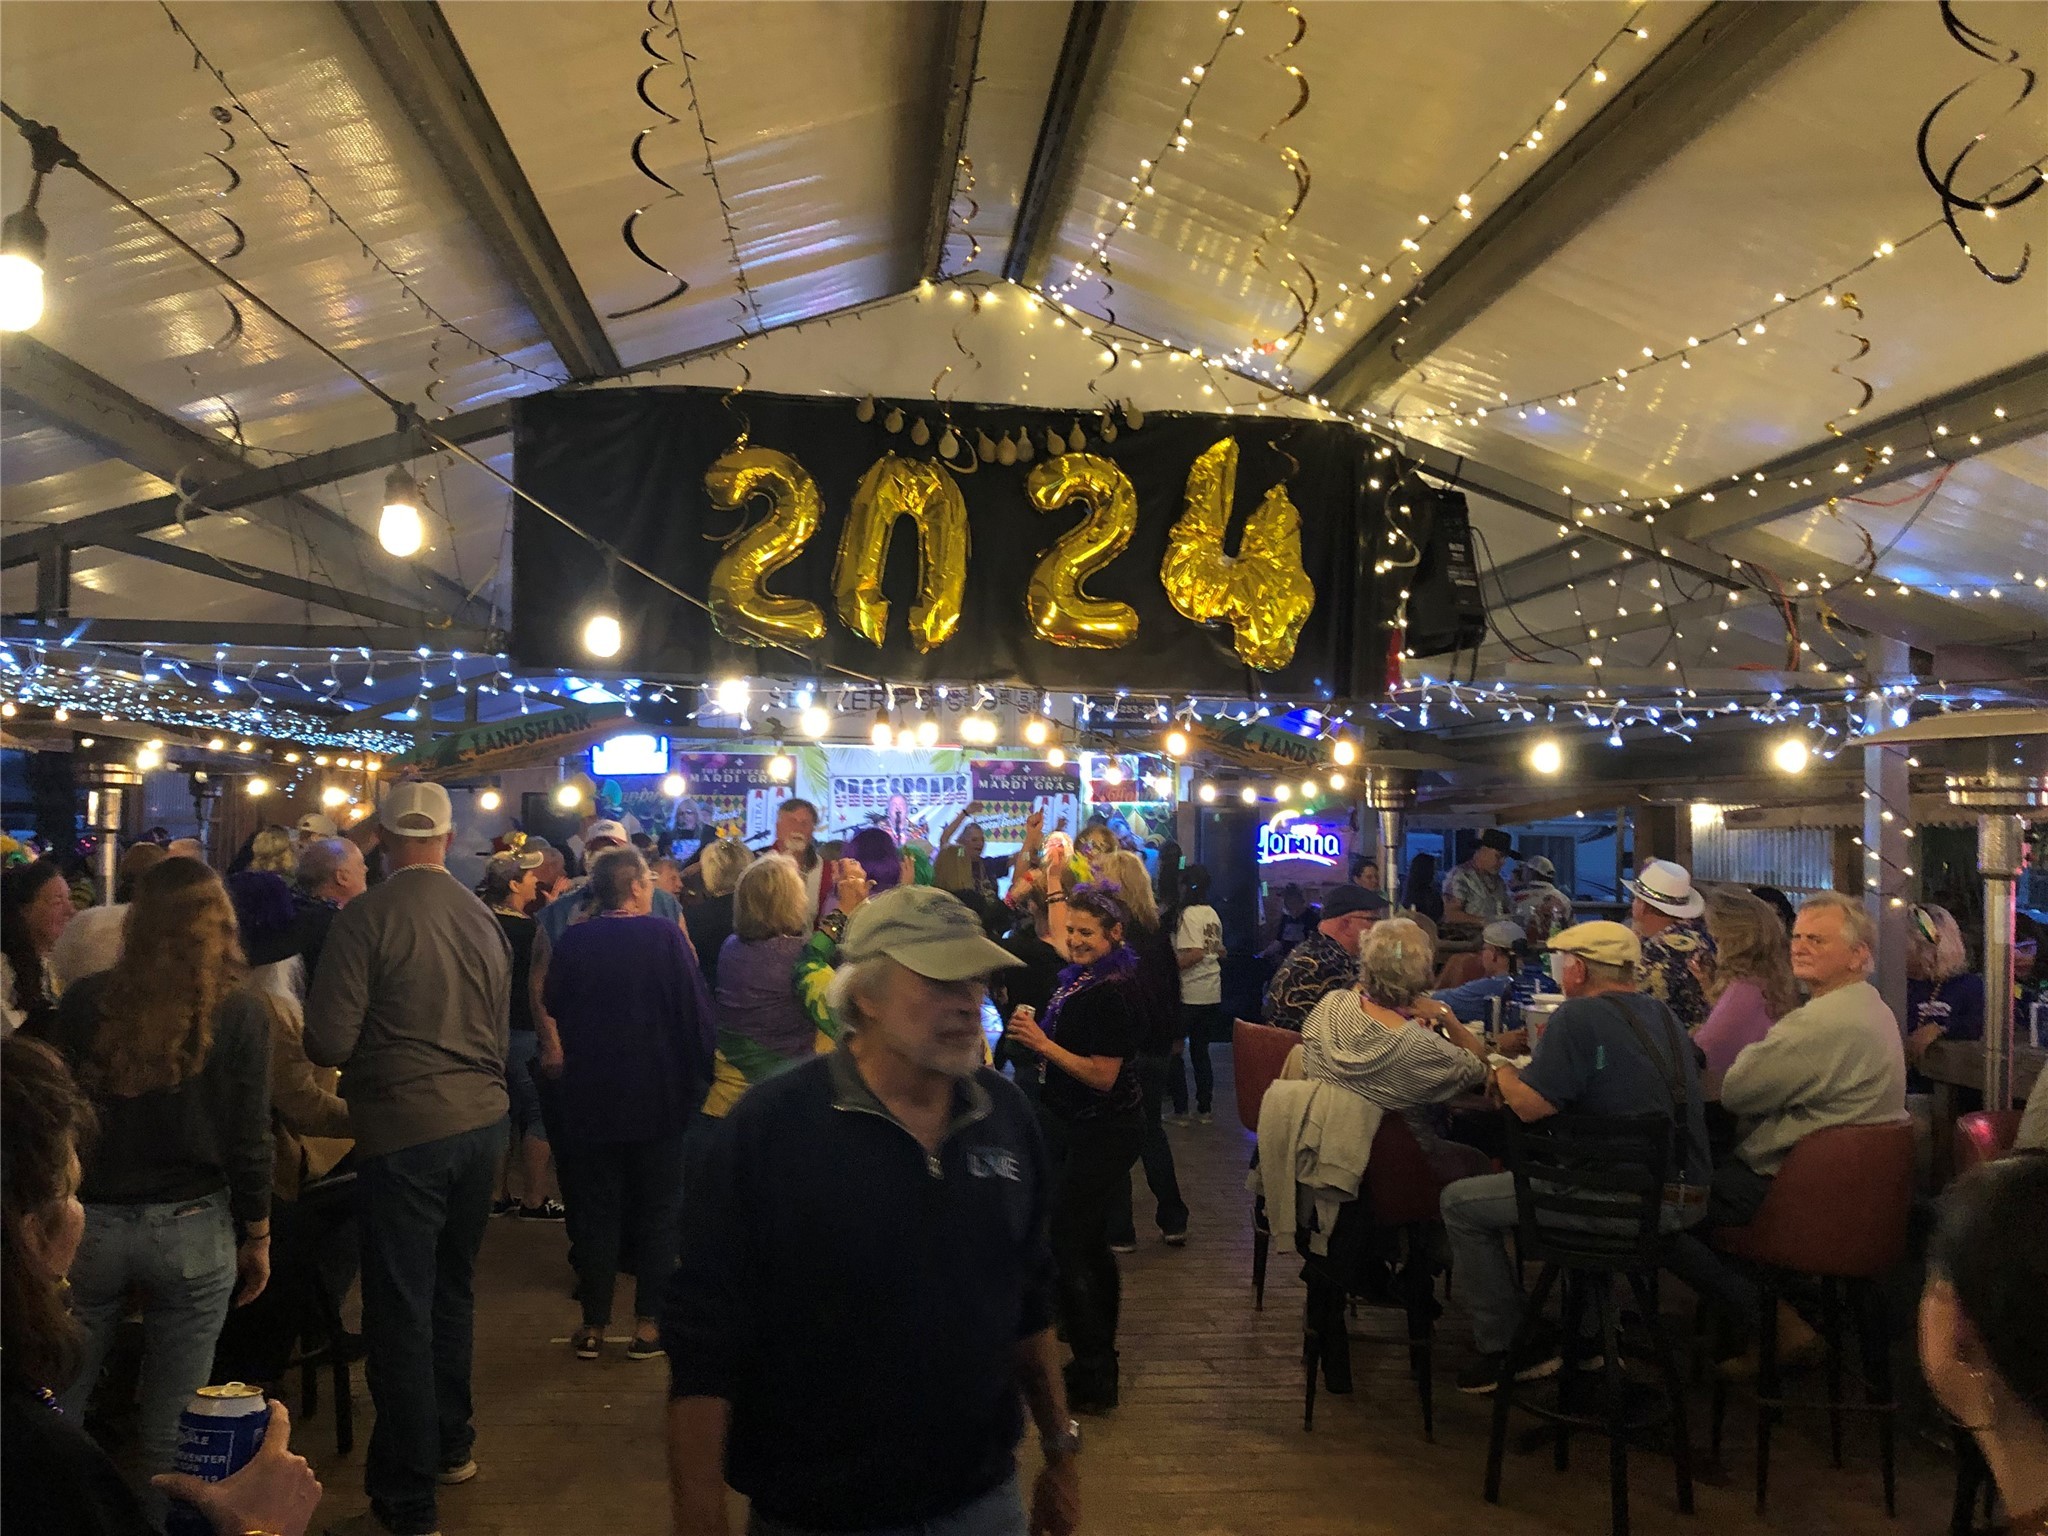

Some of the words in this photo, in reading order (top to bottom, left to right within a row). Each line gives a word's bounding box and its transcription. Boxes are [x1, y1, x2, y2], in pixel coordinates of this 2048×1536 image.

[703, 436, 1315, 671] 2024
[471, 709, 593, 756] LANDSHARK
[689, 774, 740, 783] MARDI
[979, 780, 1027, 789] MARDI
[1035, 781, 1075, 791] GRAS
